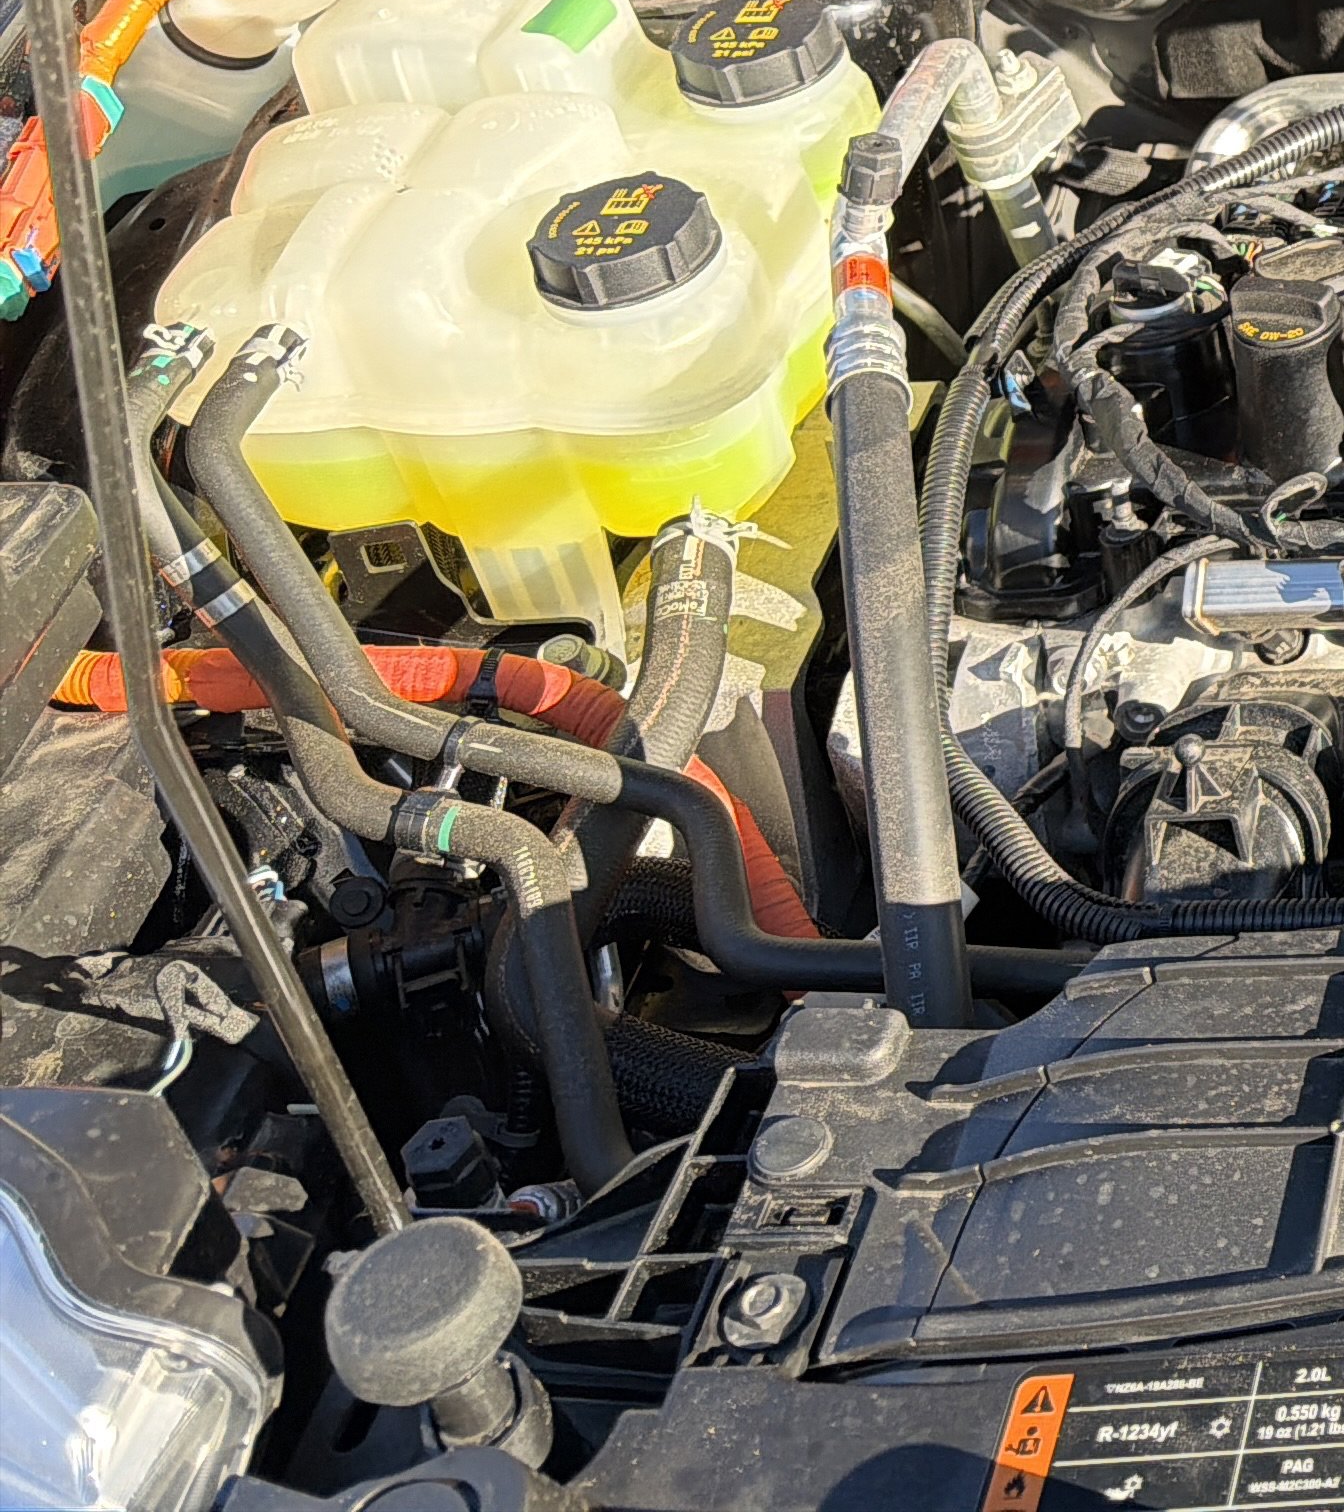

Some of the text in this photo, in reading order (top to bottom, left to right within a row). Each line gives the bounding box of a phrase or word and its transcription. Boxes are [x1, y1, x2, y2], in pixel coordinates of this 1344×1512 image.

[574, 235, 633, 246] 145 kPa
[573, 245, 622, 257] 21 psi
[1293, 1367, 1332, 1384] 2.0L
[1274, 1402, 1342, 1422] 0.550 kg
[1095, 1420, 1180, 1443] R-1234yf
[1256, 1425, 1275, 1440] 19
[1275, 1427, 1293, 1438] oz
[1294, 1422, 1327, 1441] (1.21
[1280, 1457, 1315, 1475] PAG
